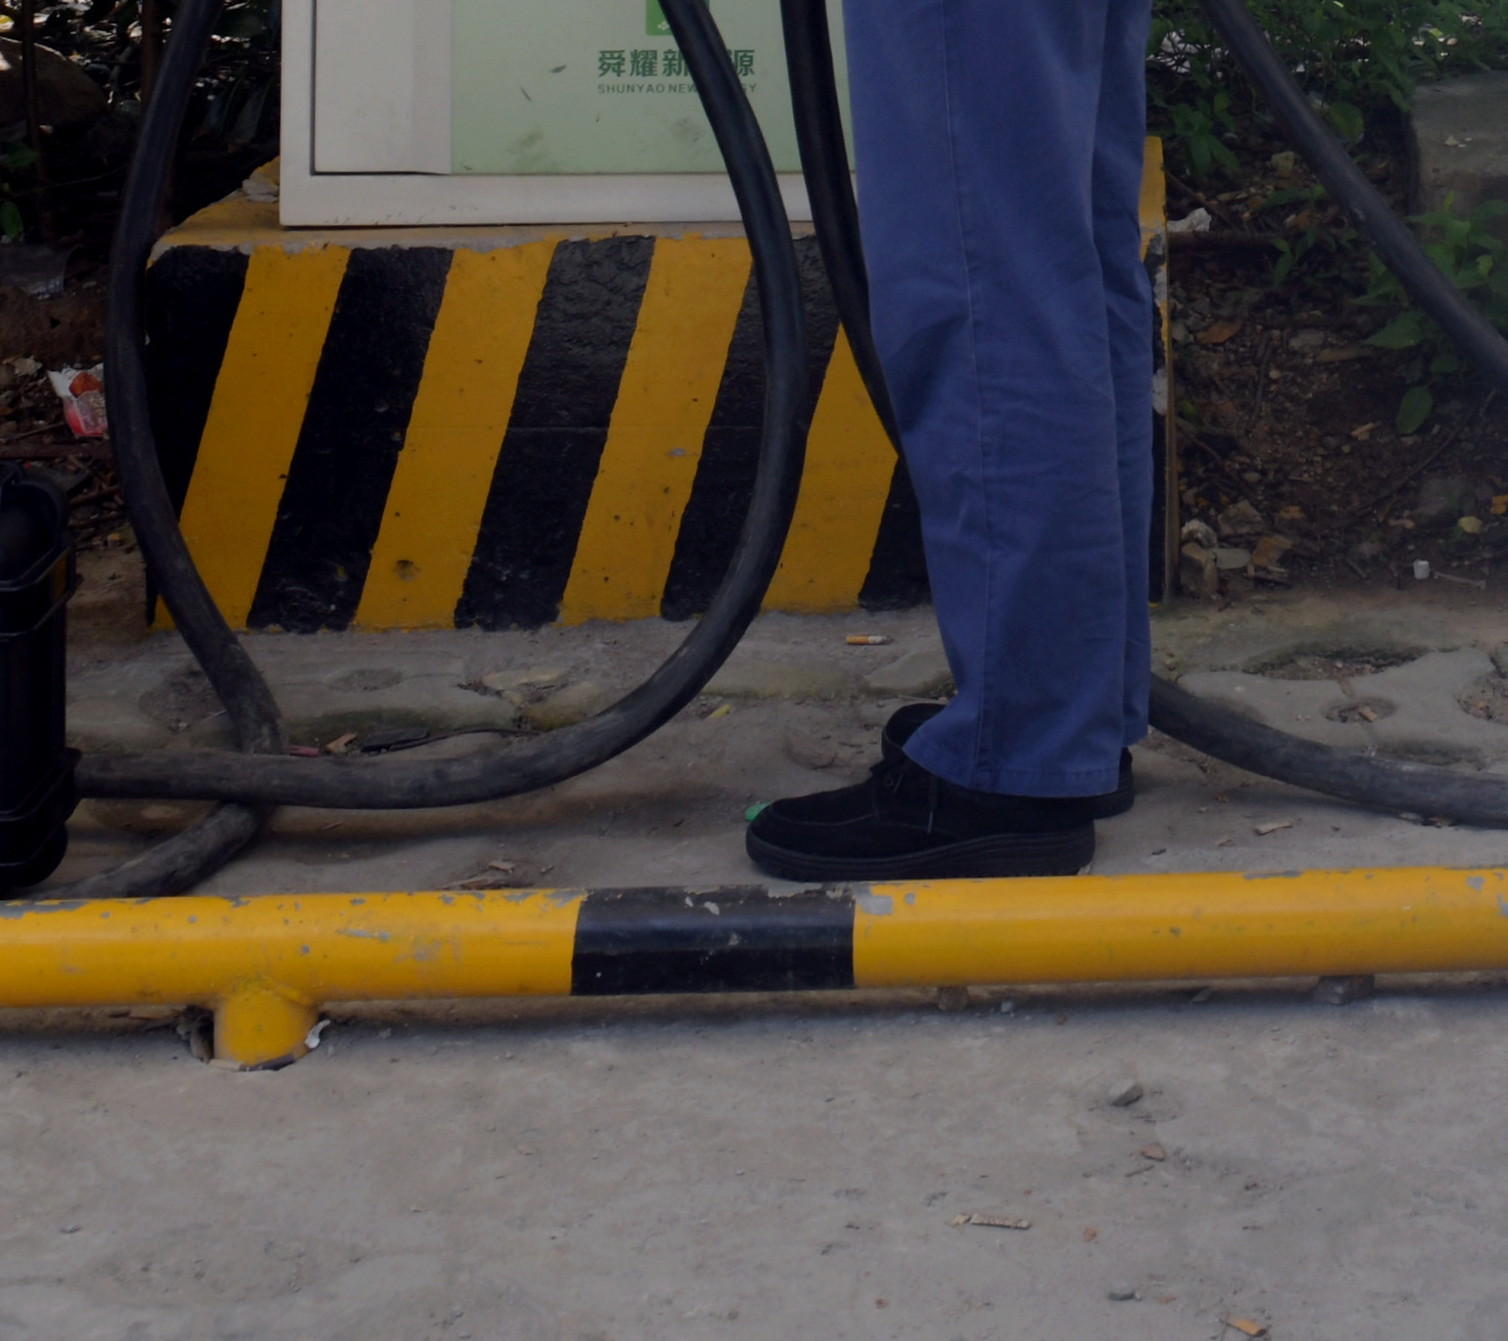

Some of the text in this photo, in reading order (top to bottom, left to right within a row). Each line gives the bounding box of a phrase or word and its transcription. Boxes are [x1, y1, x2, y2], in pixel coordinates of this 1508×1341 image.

[598, 49, 755, 77] 舜耀新源
[597, 83, 665, 94] SHUNYAO
